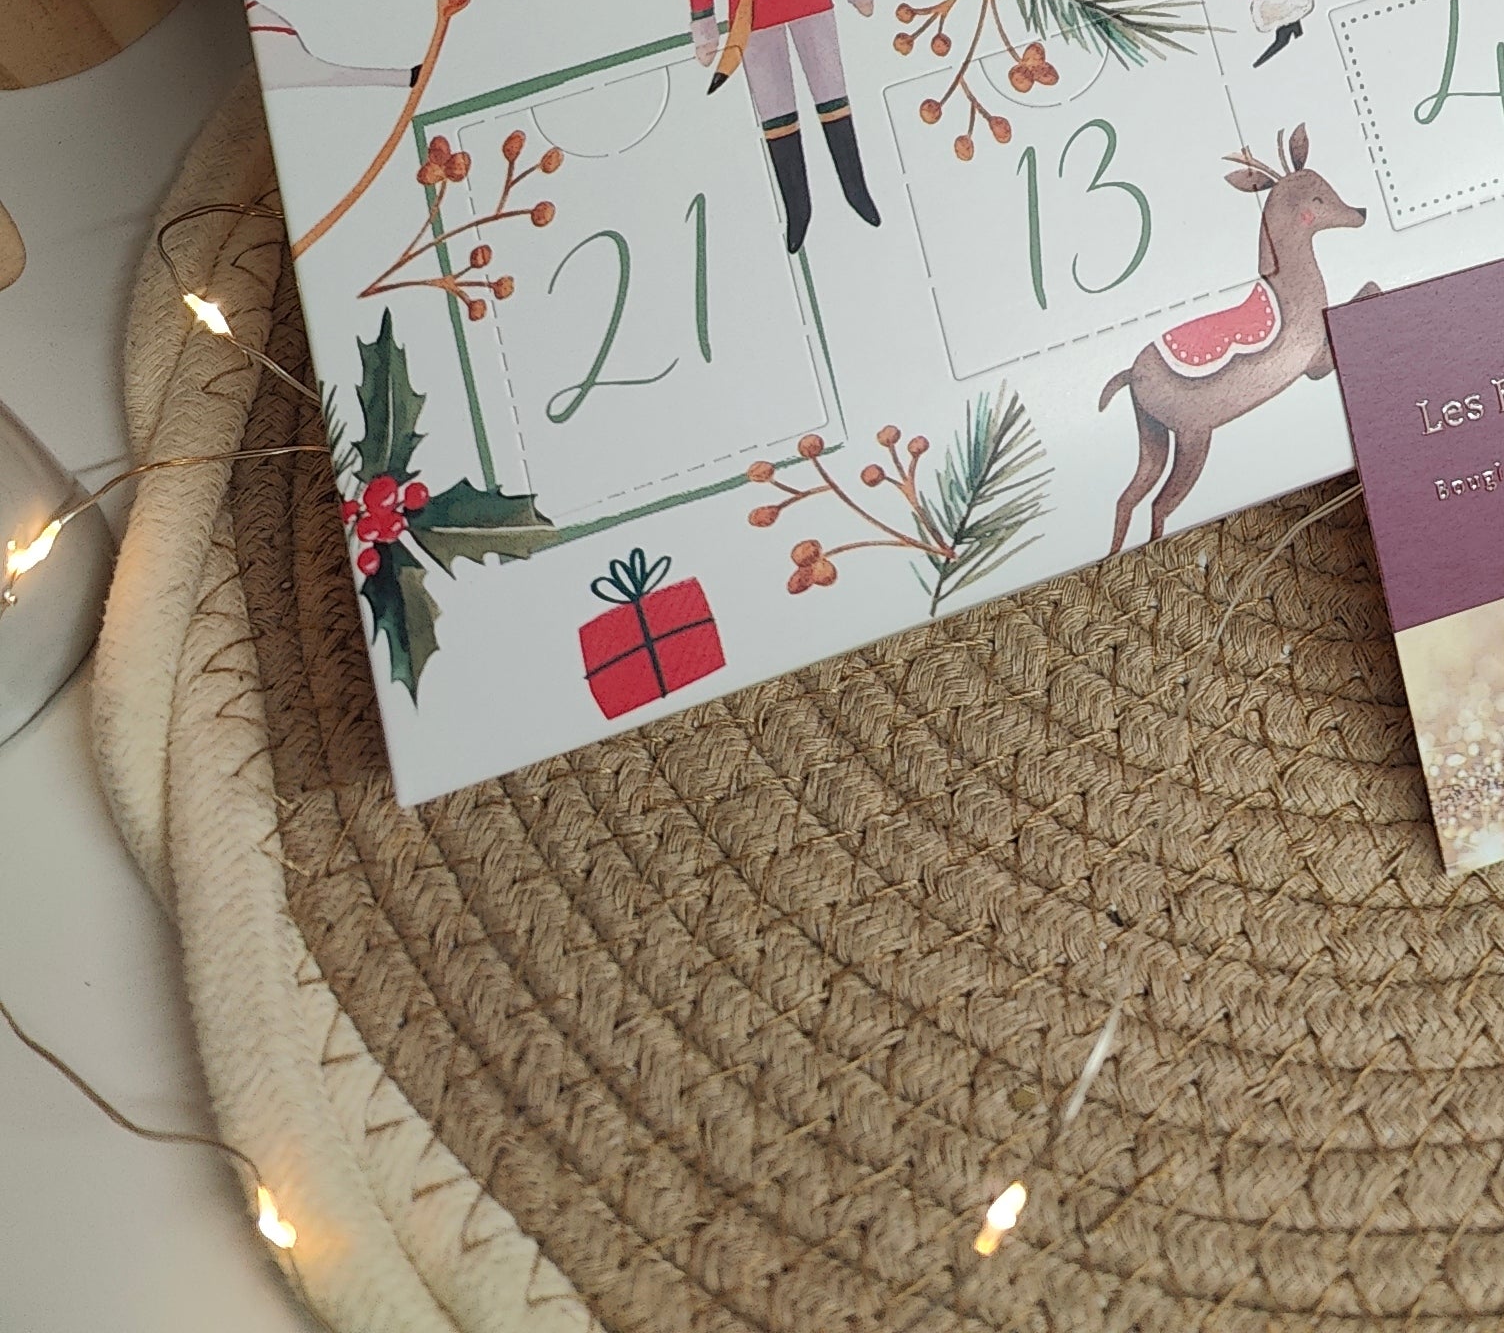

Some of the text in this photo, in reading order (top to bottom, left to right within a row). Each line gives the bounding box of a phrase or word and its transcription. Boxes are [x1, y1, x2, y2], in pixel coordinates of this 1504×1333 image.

[544, 193, 713, 424] 21
[1016, 118, 1152, 310] 13
[1416, 394, 1485, 436] Les
